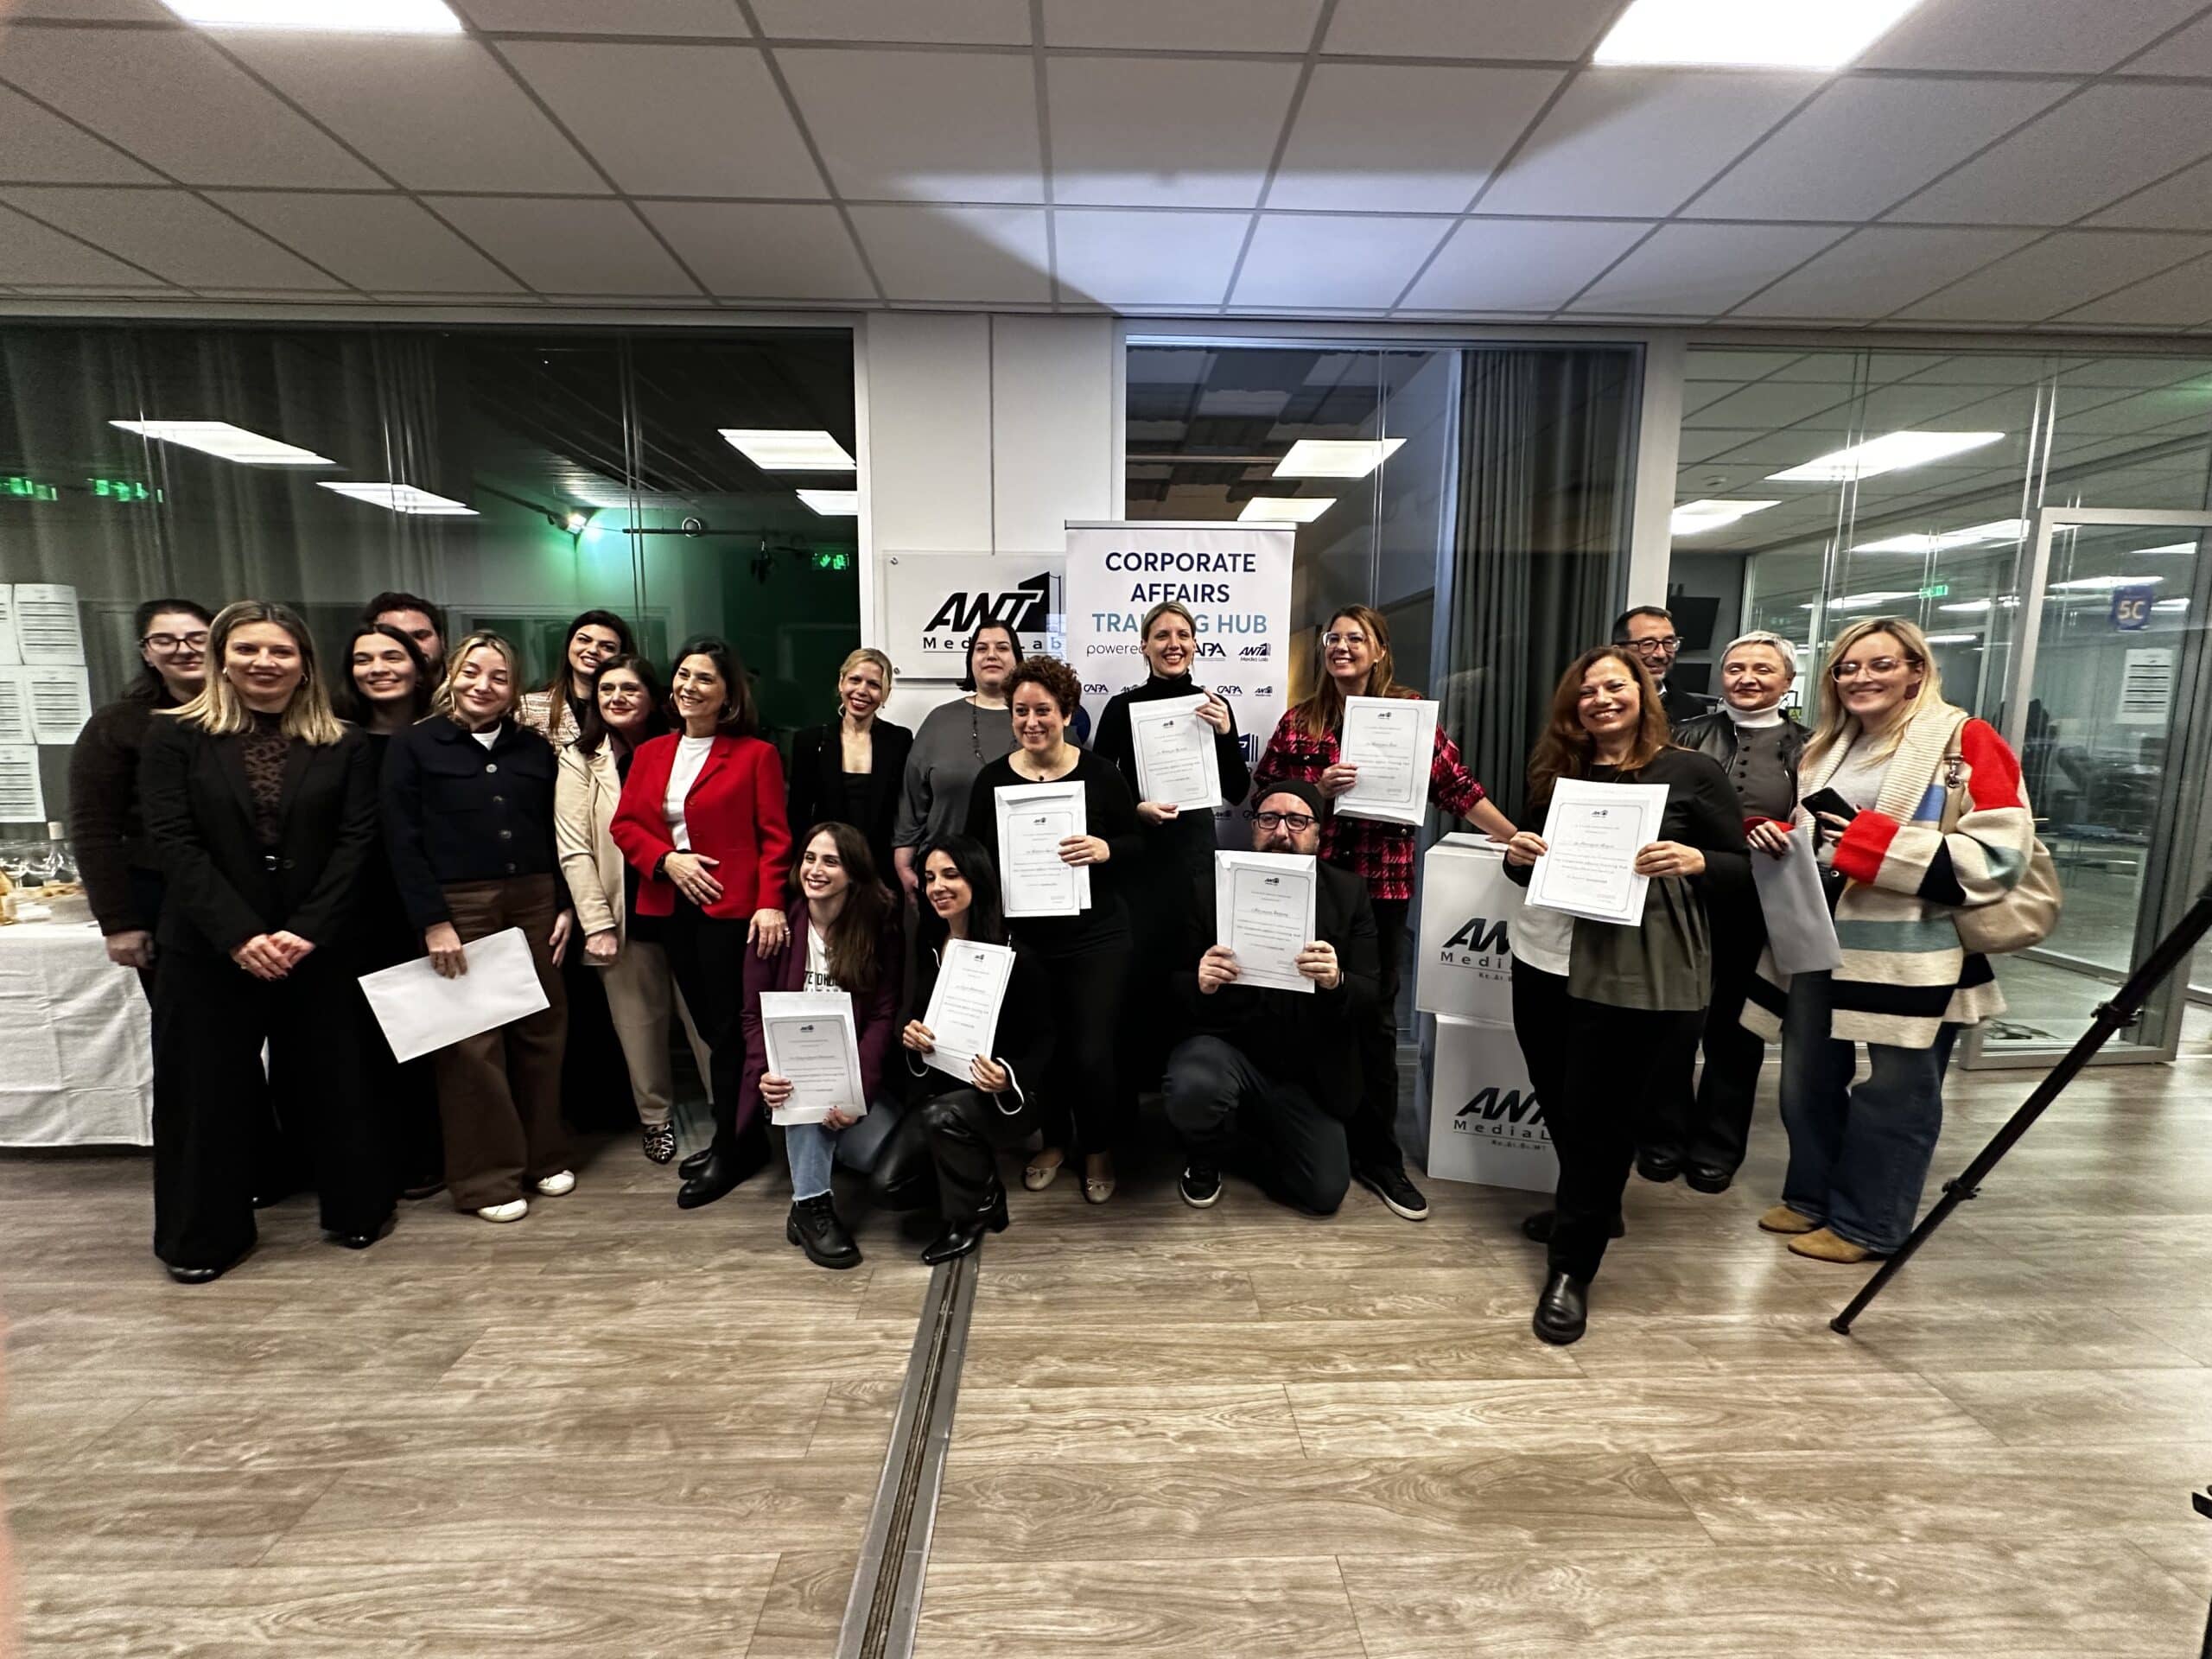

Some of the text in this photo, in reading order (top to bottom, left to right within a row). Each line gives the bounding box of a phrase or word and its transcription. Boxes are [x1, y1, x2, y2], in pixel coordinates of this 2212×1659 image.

[1105, 552, 1256, 572] CORPORATE
[1130, 583, 1230, 602] AFFAIRS
[1217, 614, 1267, 633] HUB
[1084, 683, 1109, 693] CAPA
[1217, 685, 1243, 694] CAPA
